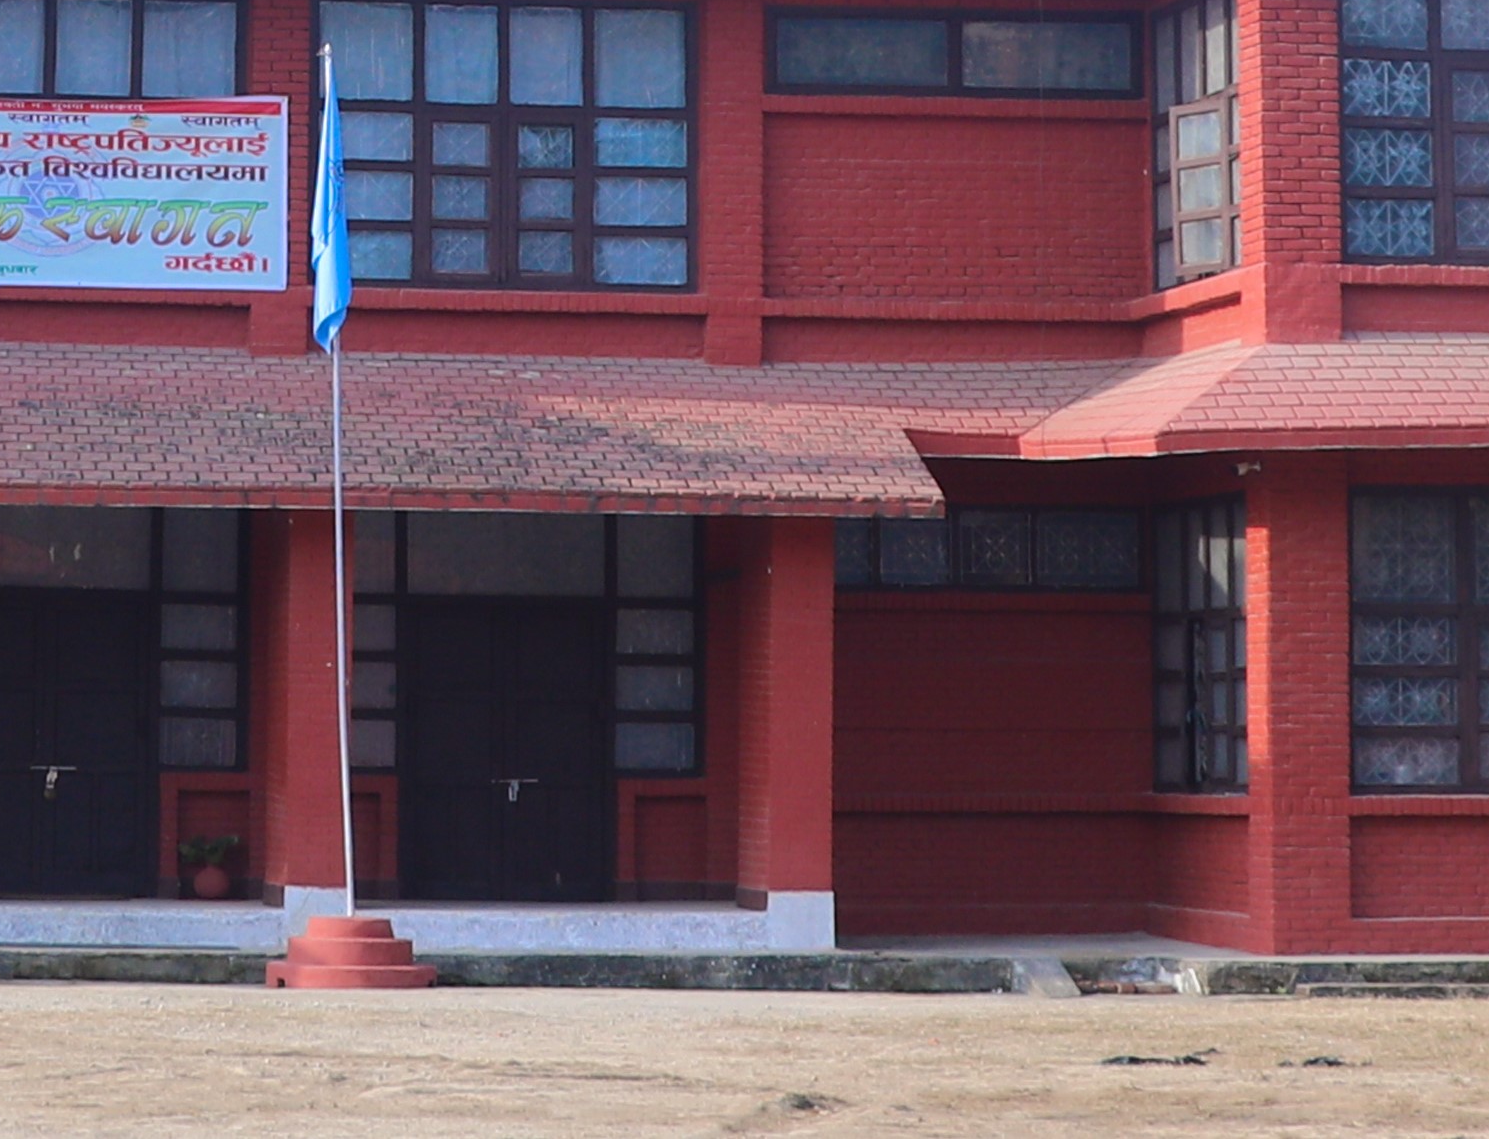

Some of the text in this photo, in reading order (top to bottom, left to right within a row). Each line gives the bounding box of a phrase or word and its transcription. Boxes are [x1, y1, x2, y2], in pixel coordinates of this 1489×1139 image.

[8, 112, 90, 127] स्वागतम्
[181, 115, 262, 129] स्वागतम्
[24, 128, 269, 156] राष्ट्रपतिज्यूलाई
[41, 155, 269, 182] विश्वविद्यालयमा
[40, 197, 269, 248] स्वागत
